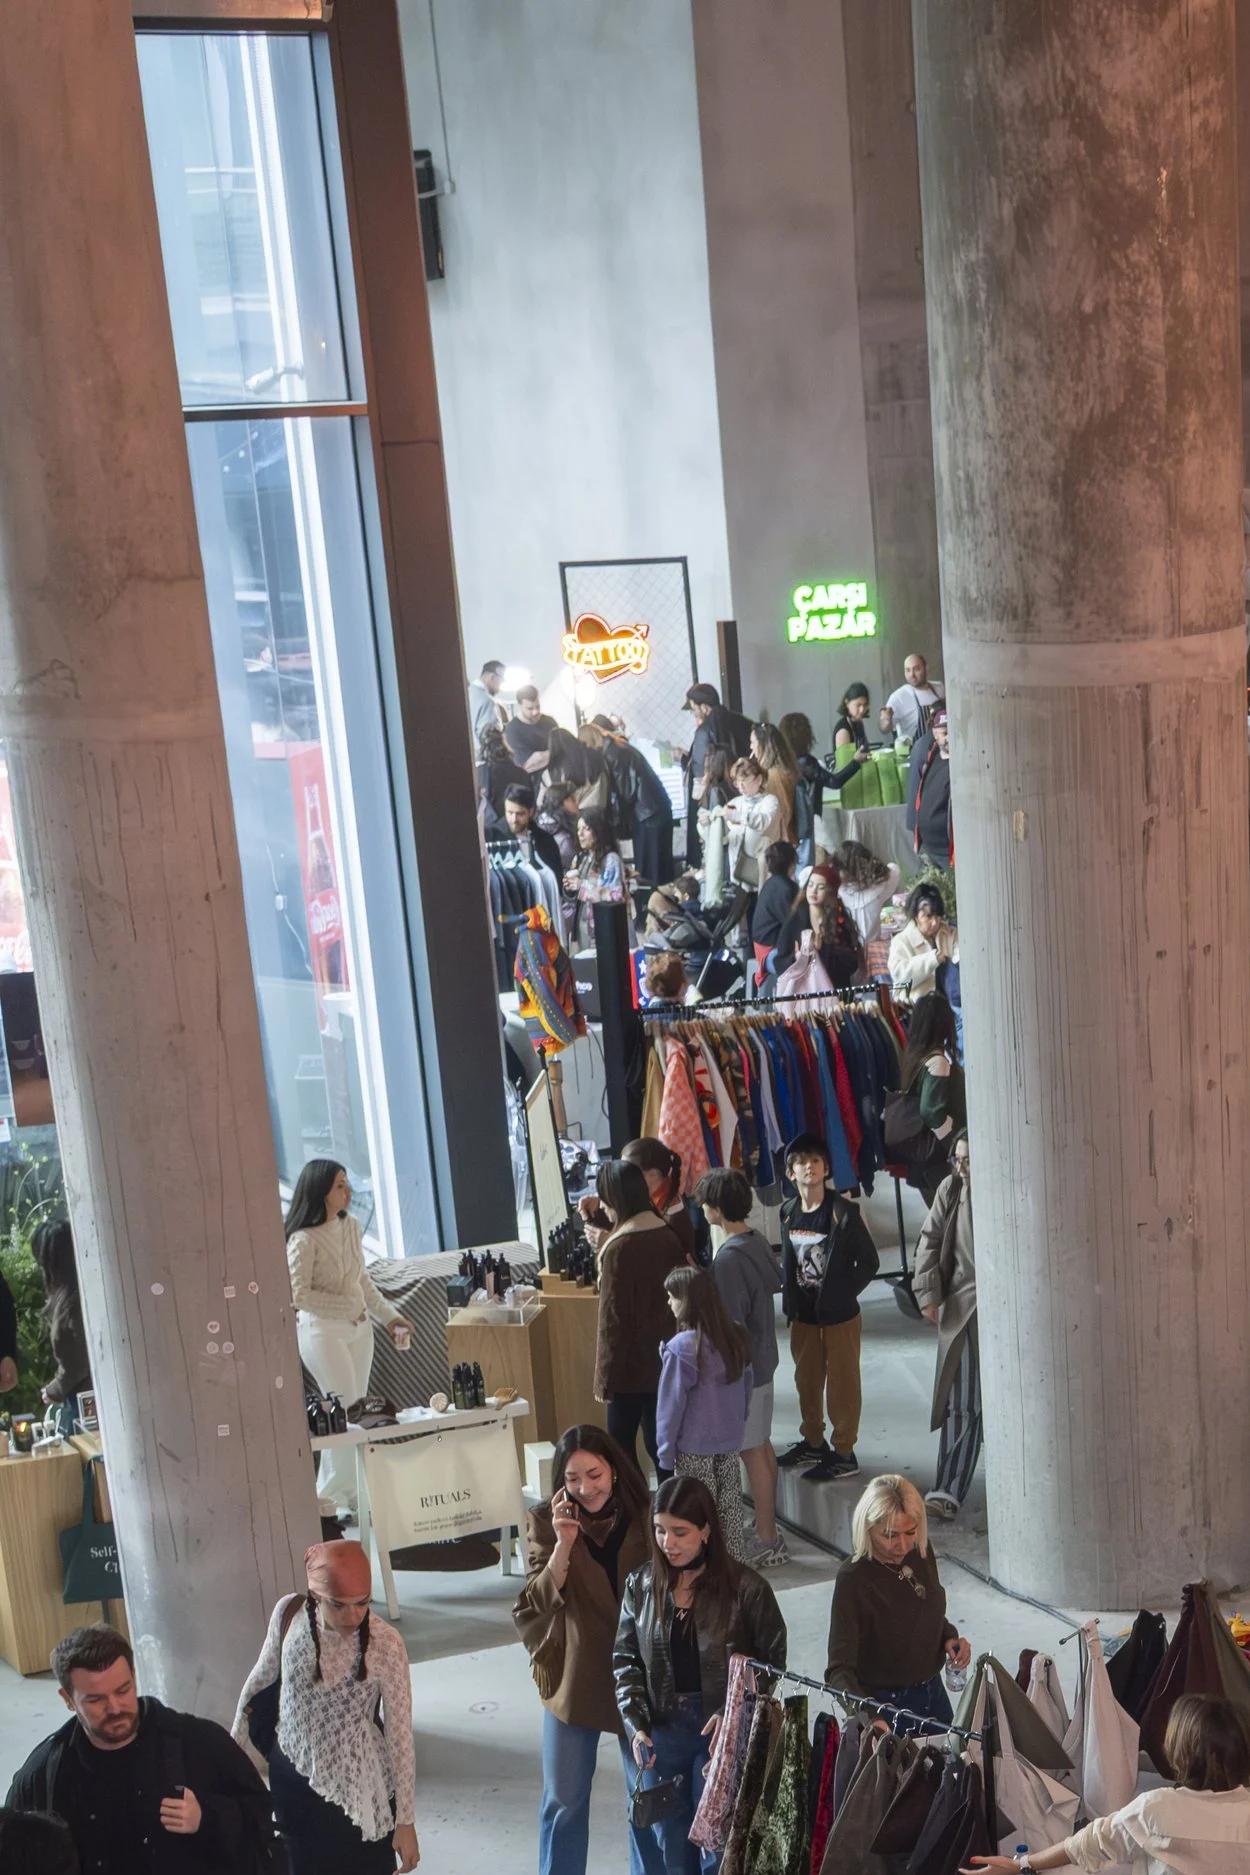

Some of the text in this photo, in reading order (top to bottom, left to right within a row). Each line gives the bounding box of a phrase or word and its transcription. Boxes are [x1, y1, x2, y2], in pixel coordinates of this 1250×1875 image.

[792, 582, 868, 618] ÇARŞI
[787, 612, 877, 643] PAZAR
[571, 641, 643, 667] TATTOO
[420, 1488, 472, 1508] RITUALS
